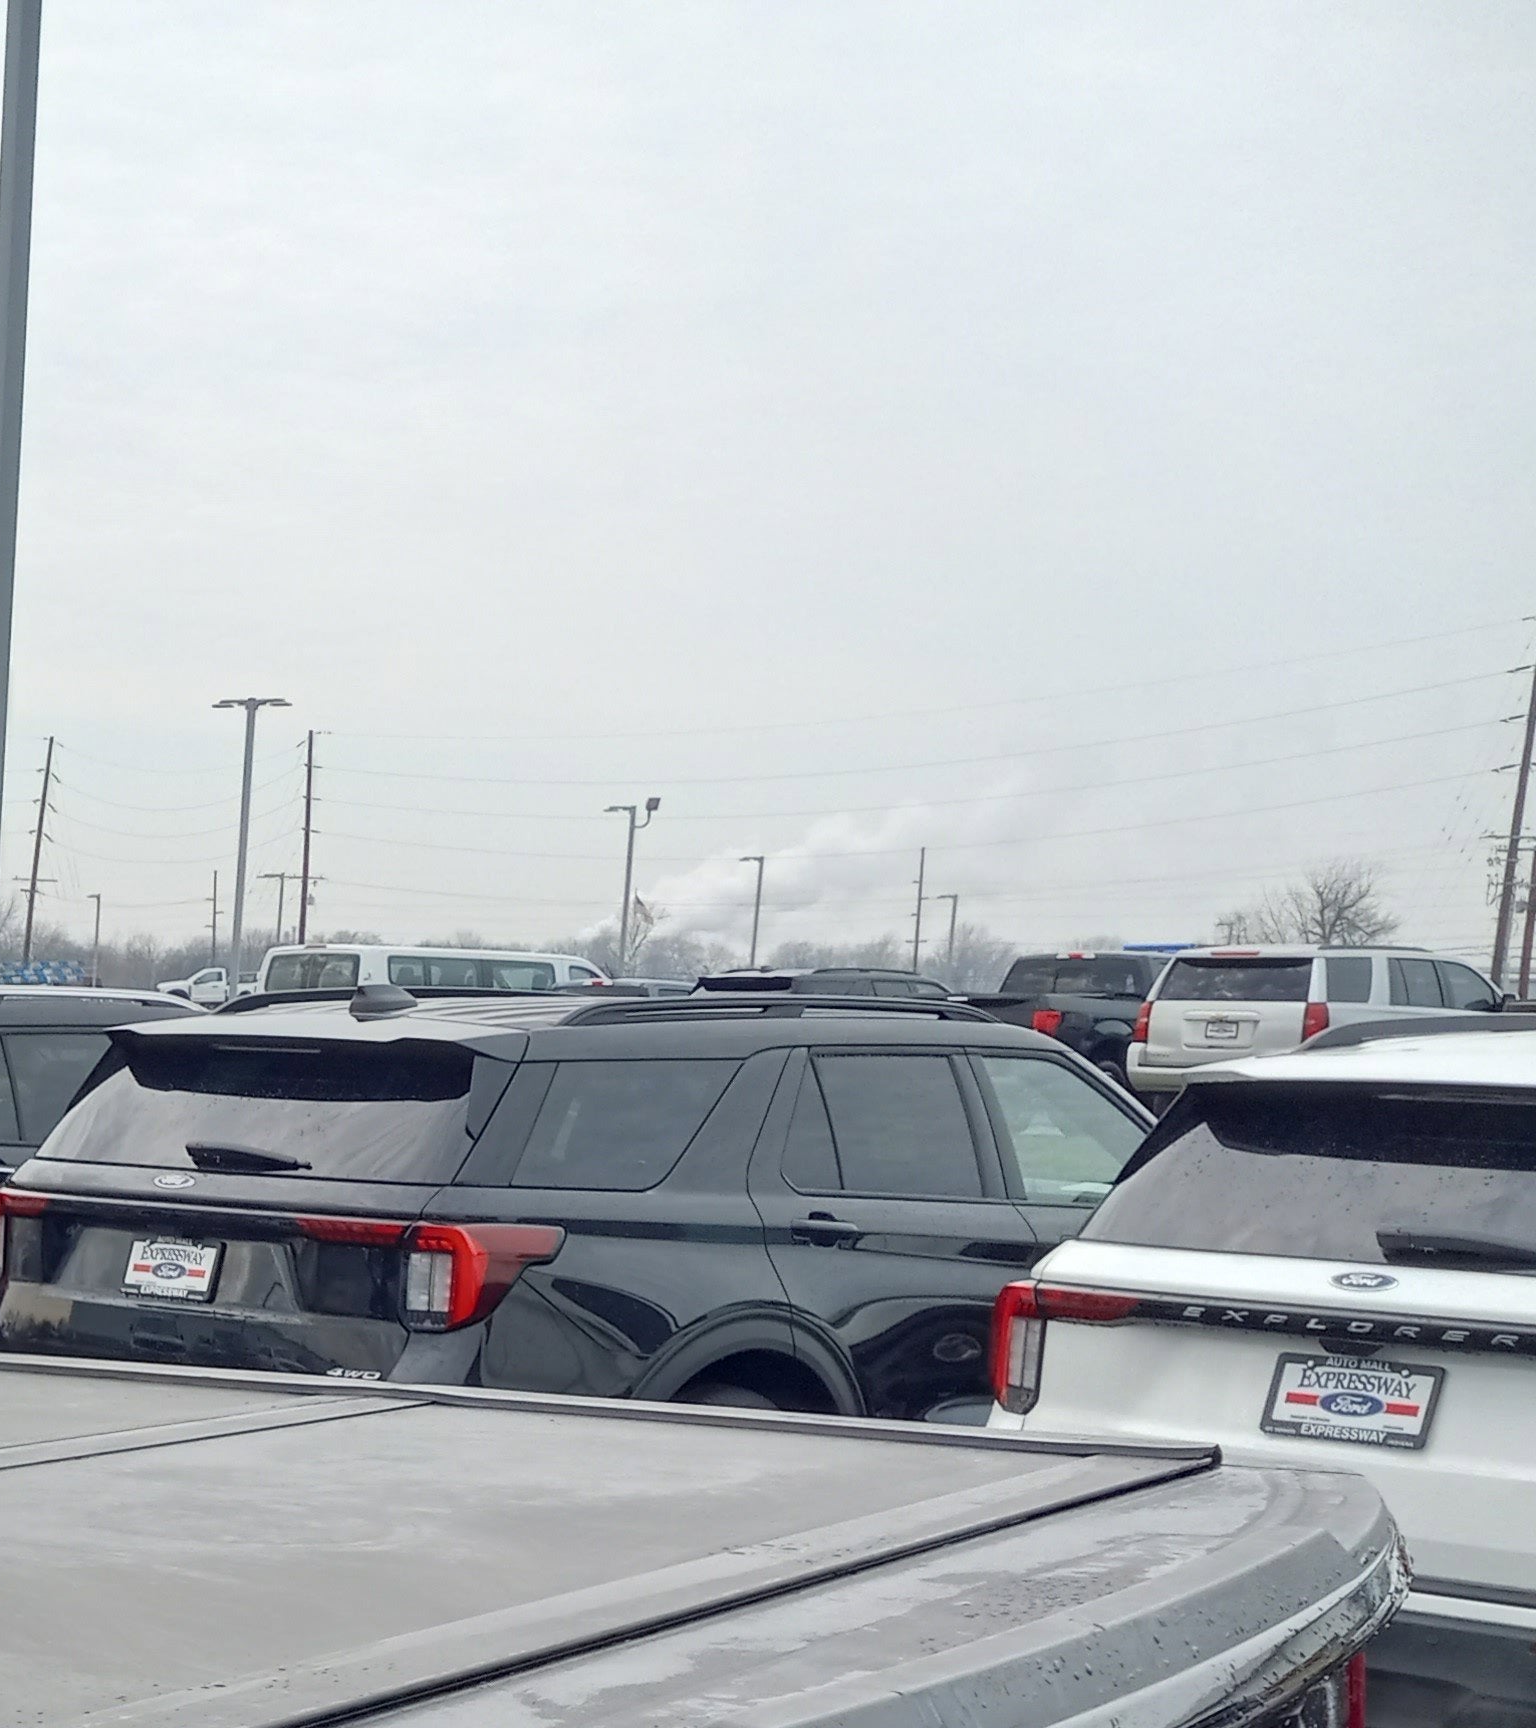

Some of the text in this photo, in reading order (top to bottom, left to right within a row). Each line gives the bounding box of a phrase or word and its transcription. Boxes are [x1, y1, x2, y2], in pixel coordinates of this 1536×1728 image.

[140, 1245, 205, 1266] EXPRESSWAY
[140, 1283, 189, 1298] EXPRESSWAY
[1181, 1305, 1521, 1348] EXPLORER
[326, 1367, 382, 1381] 4WD
[1326, 1357, 1392, 1372] AUTO MALL
[1298, 1367, 1416, 1400] EXPRESSWAY
[1300, 1423, 1387, 1445] EXPRESSWAY
